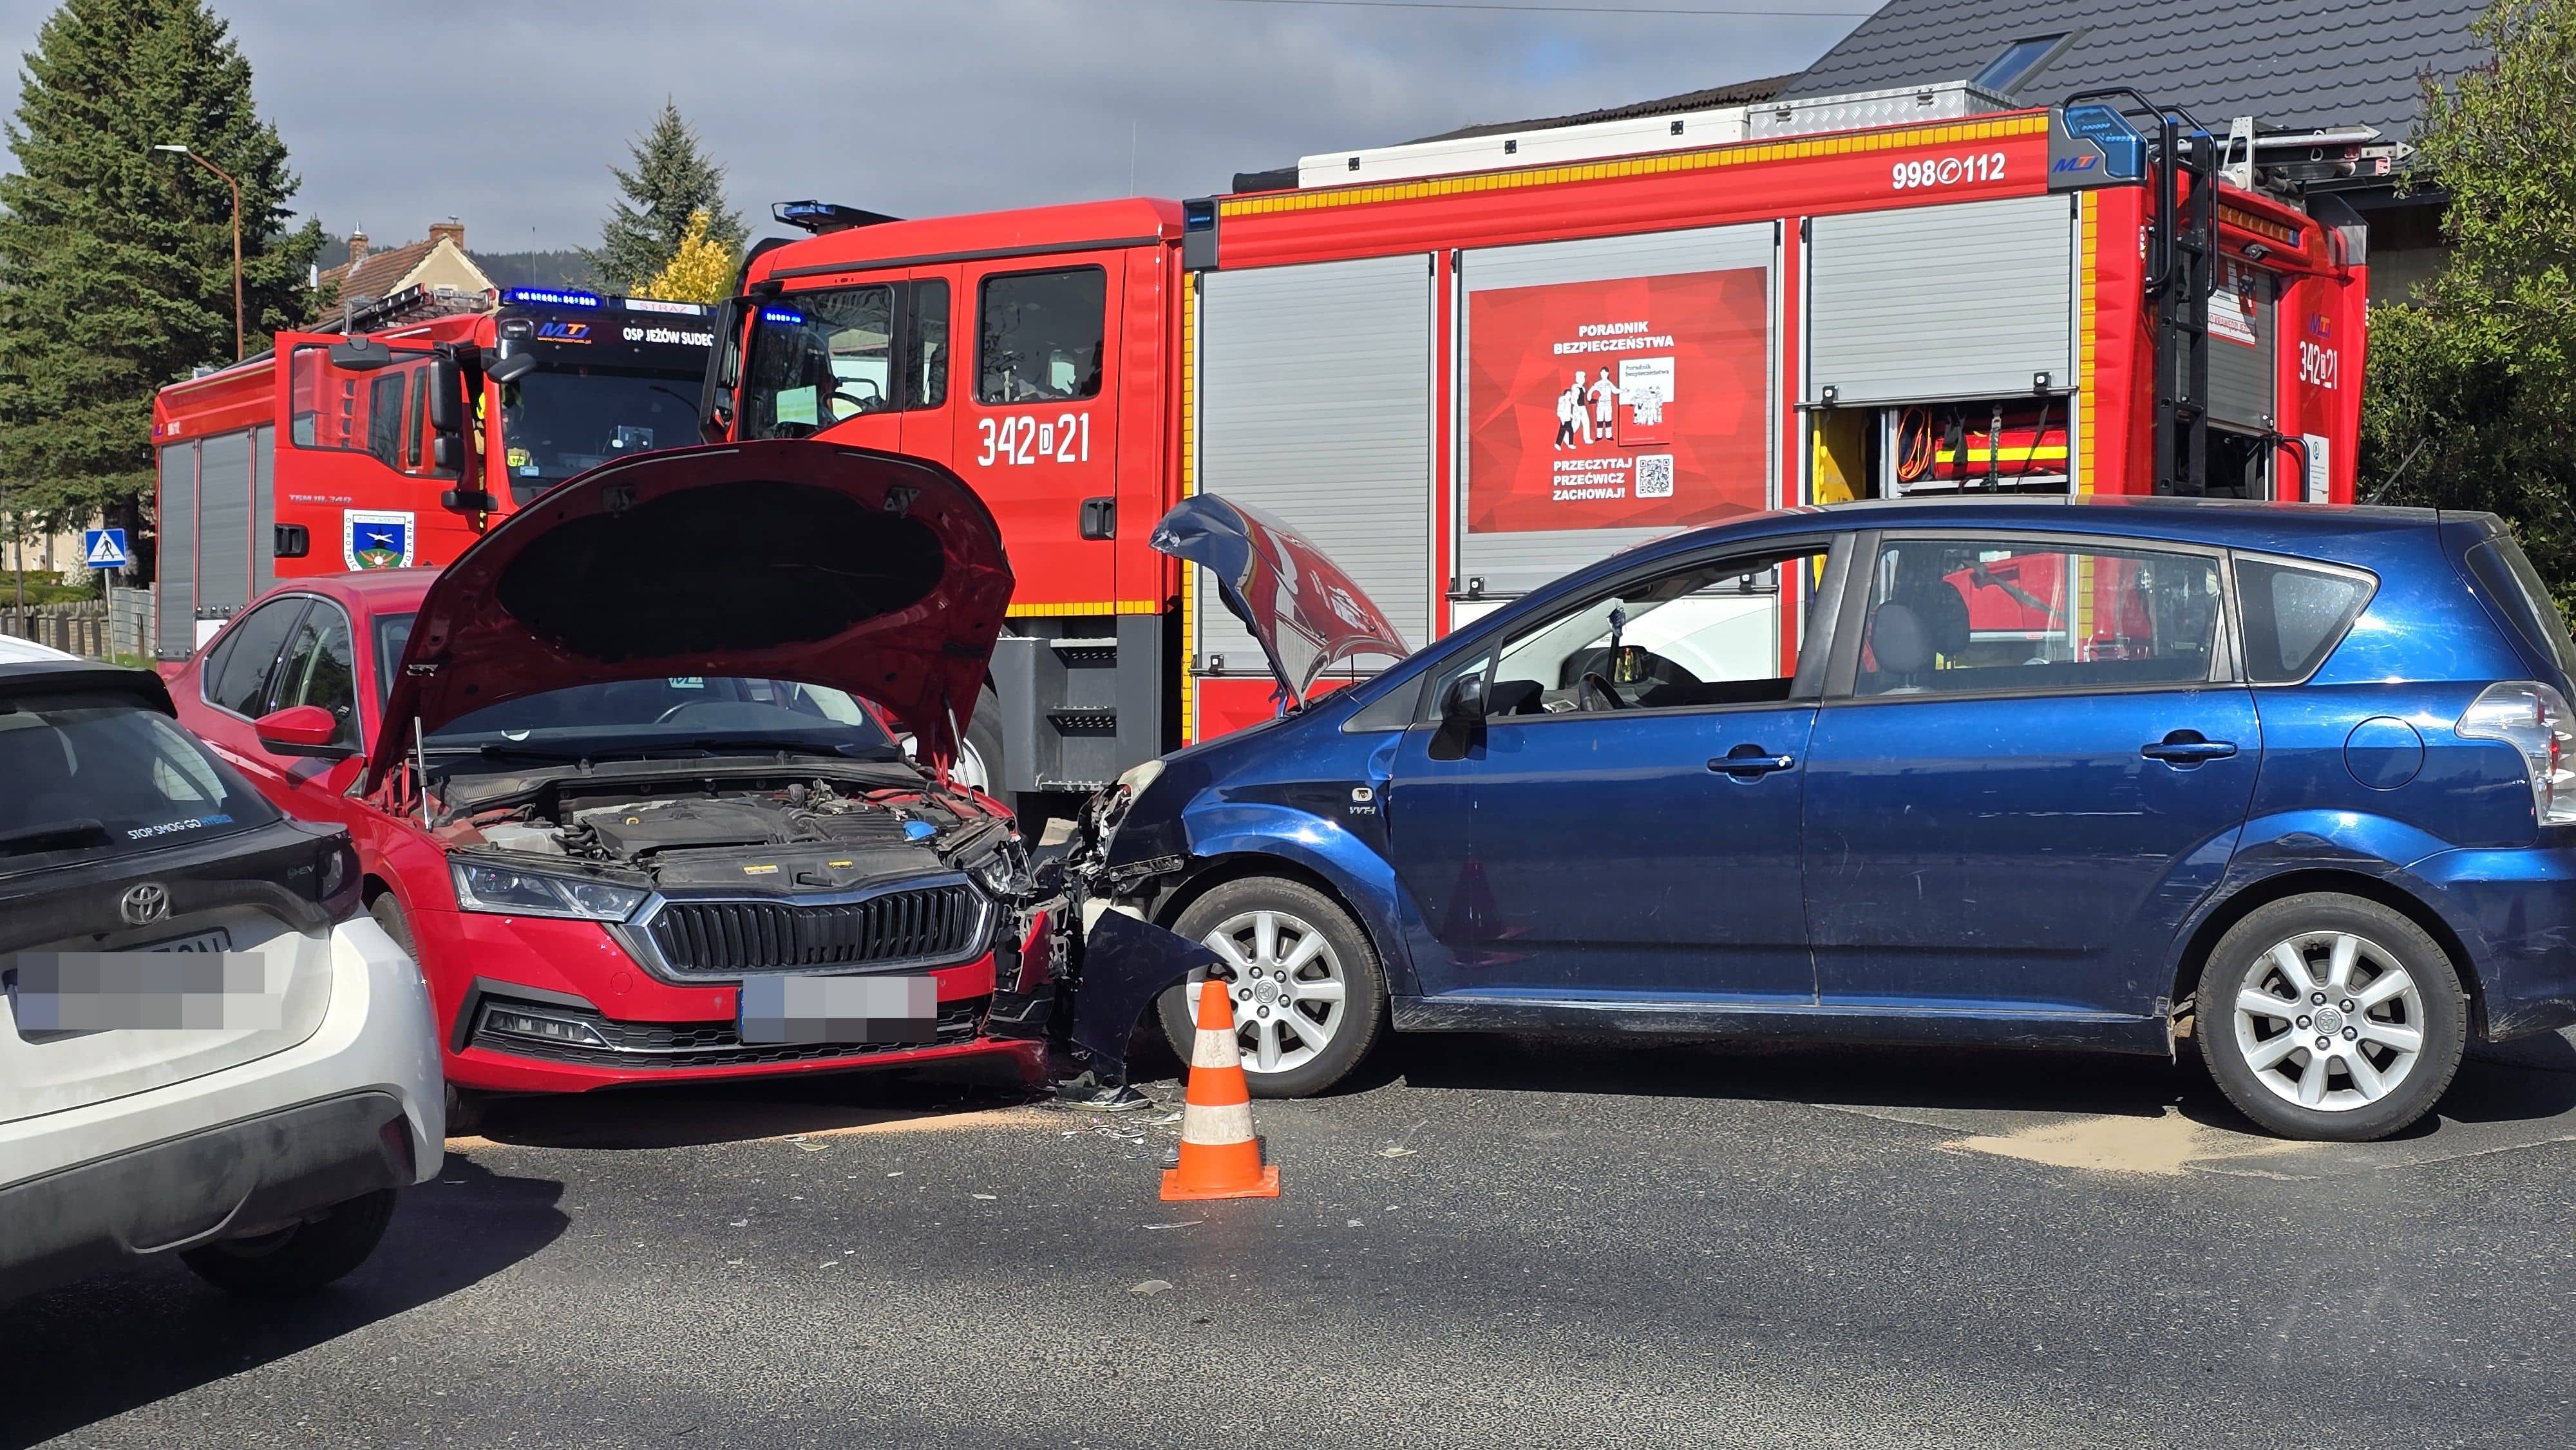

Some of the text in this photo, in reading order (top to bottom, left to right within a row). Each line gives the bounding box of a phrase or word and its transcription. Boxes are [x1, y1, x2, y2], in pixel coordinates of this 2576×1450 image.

[1892, 152, 2005, 190] 998 112
[623, 326, 644, 342] OSP
[645, 327, 680, 344] JEŻÓW
[1578, 321, 1649, 337] PORADNIK
[1553, 334, 1675, 355] BEZPIECZEŃSTWA
[1553, 457, 1633, 472] PRZECZYTAJ
[1553, 472, 1625, 486] PRZEĆWICZ
[1553, 487, 1626, 501] ZACHOWAJ!
[128, 827, 153, 840] STOP
[153, 822, 185, 834] SMOG
[184, 818, 202, 829] GO
